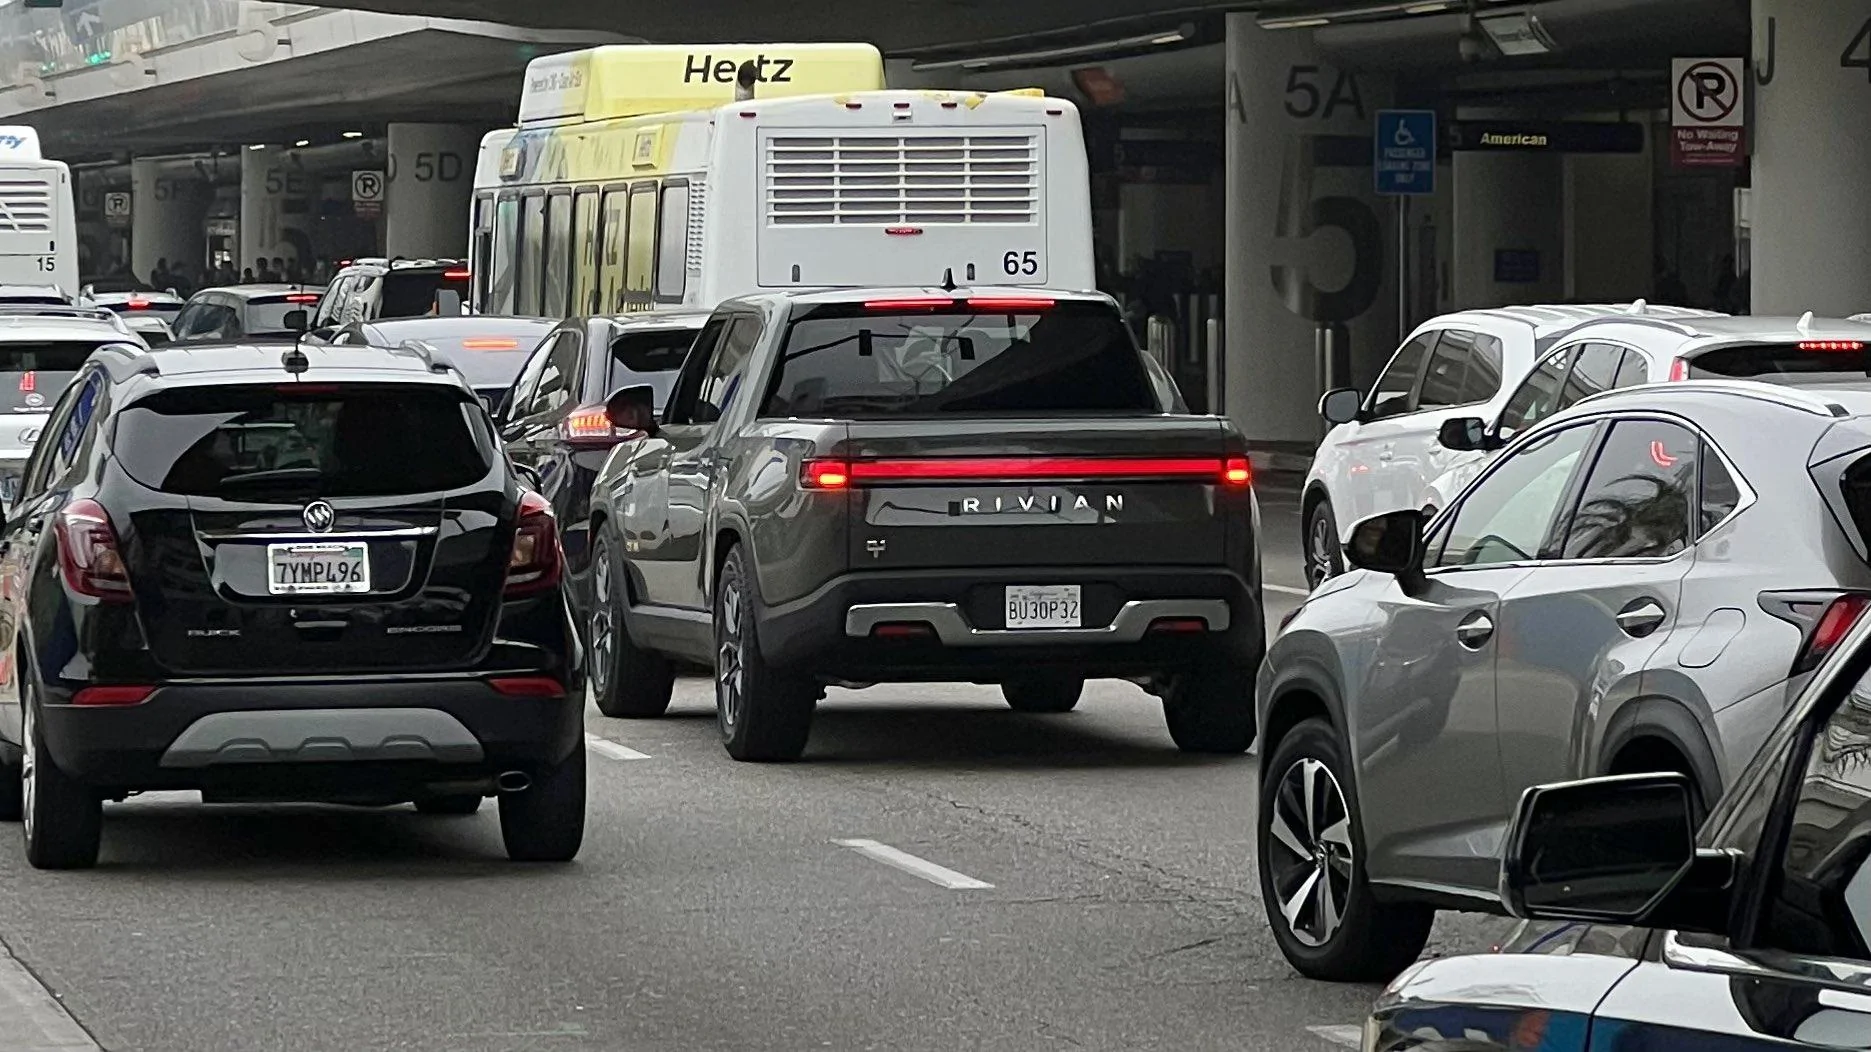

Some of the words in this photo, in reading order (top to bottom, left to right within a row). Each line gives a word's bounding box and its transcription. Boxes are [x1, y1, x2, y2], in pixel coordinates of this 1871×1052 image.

[1284, 65, 1366, 120] 5A
[1480, 132, 1547, 145] American
[1677, 129, 1694, 140] No
[1696, 129, 1739, 141] Waiting
[415, 151, 463, 182] 5D
[1270, 134, 1383, 322] 5
[37, 257, 55, 271] 15
[1003, 251, 1038, 275] 65
[963, 495, 1123, 512] RIVIAN
[276, 562, 362, 583] 7YMP496
